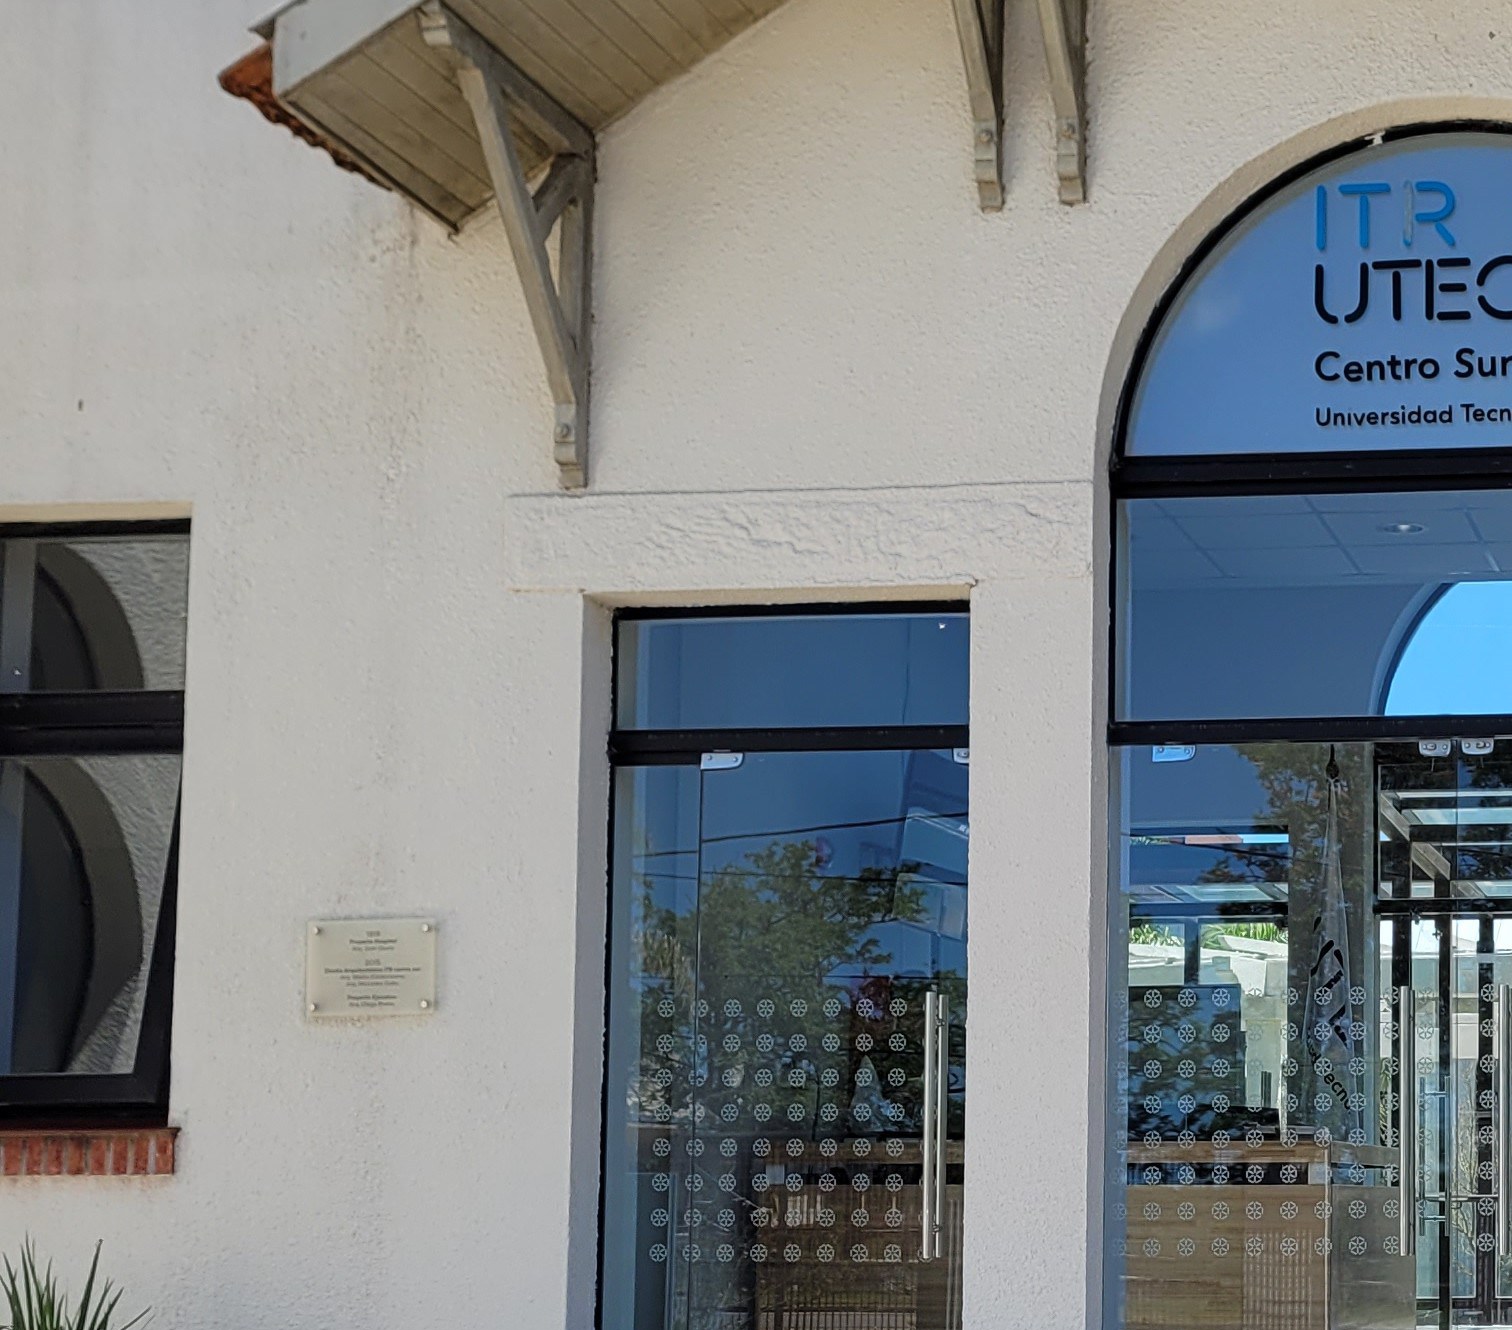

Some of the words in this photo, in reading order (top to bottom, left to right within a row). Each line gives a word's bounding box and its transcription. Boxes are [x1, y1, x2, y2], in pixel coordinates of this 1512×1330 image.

[1316, 181, 1457, 251] ITR
[1314, 350, 1441, 382] Centro
[1315, 404, 1453, 427] Universidad
